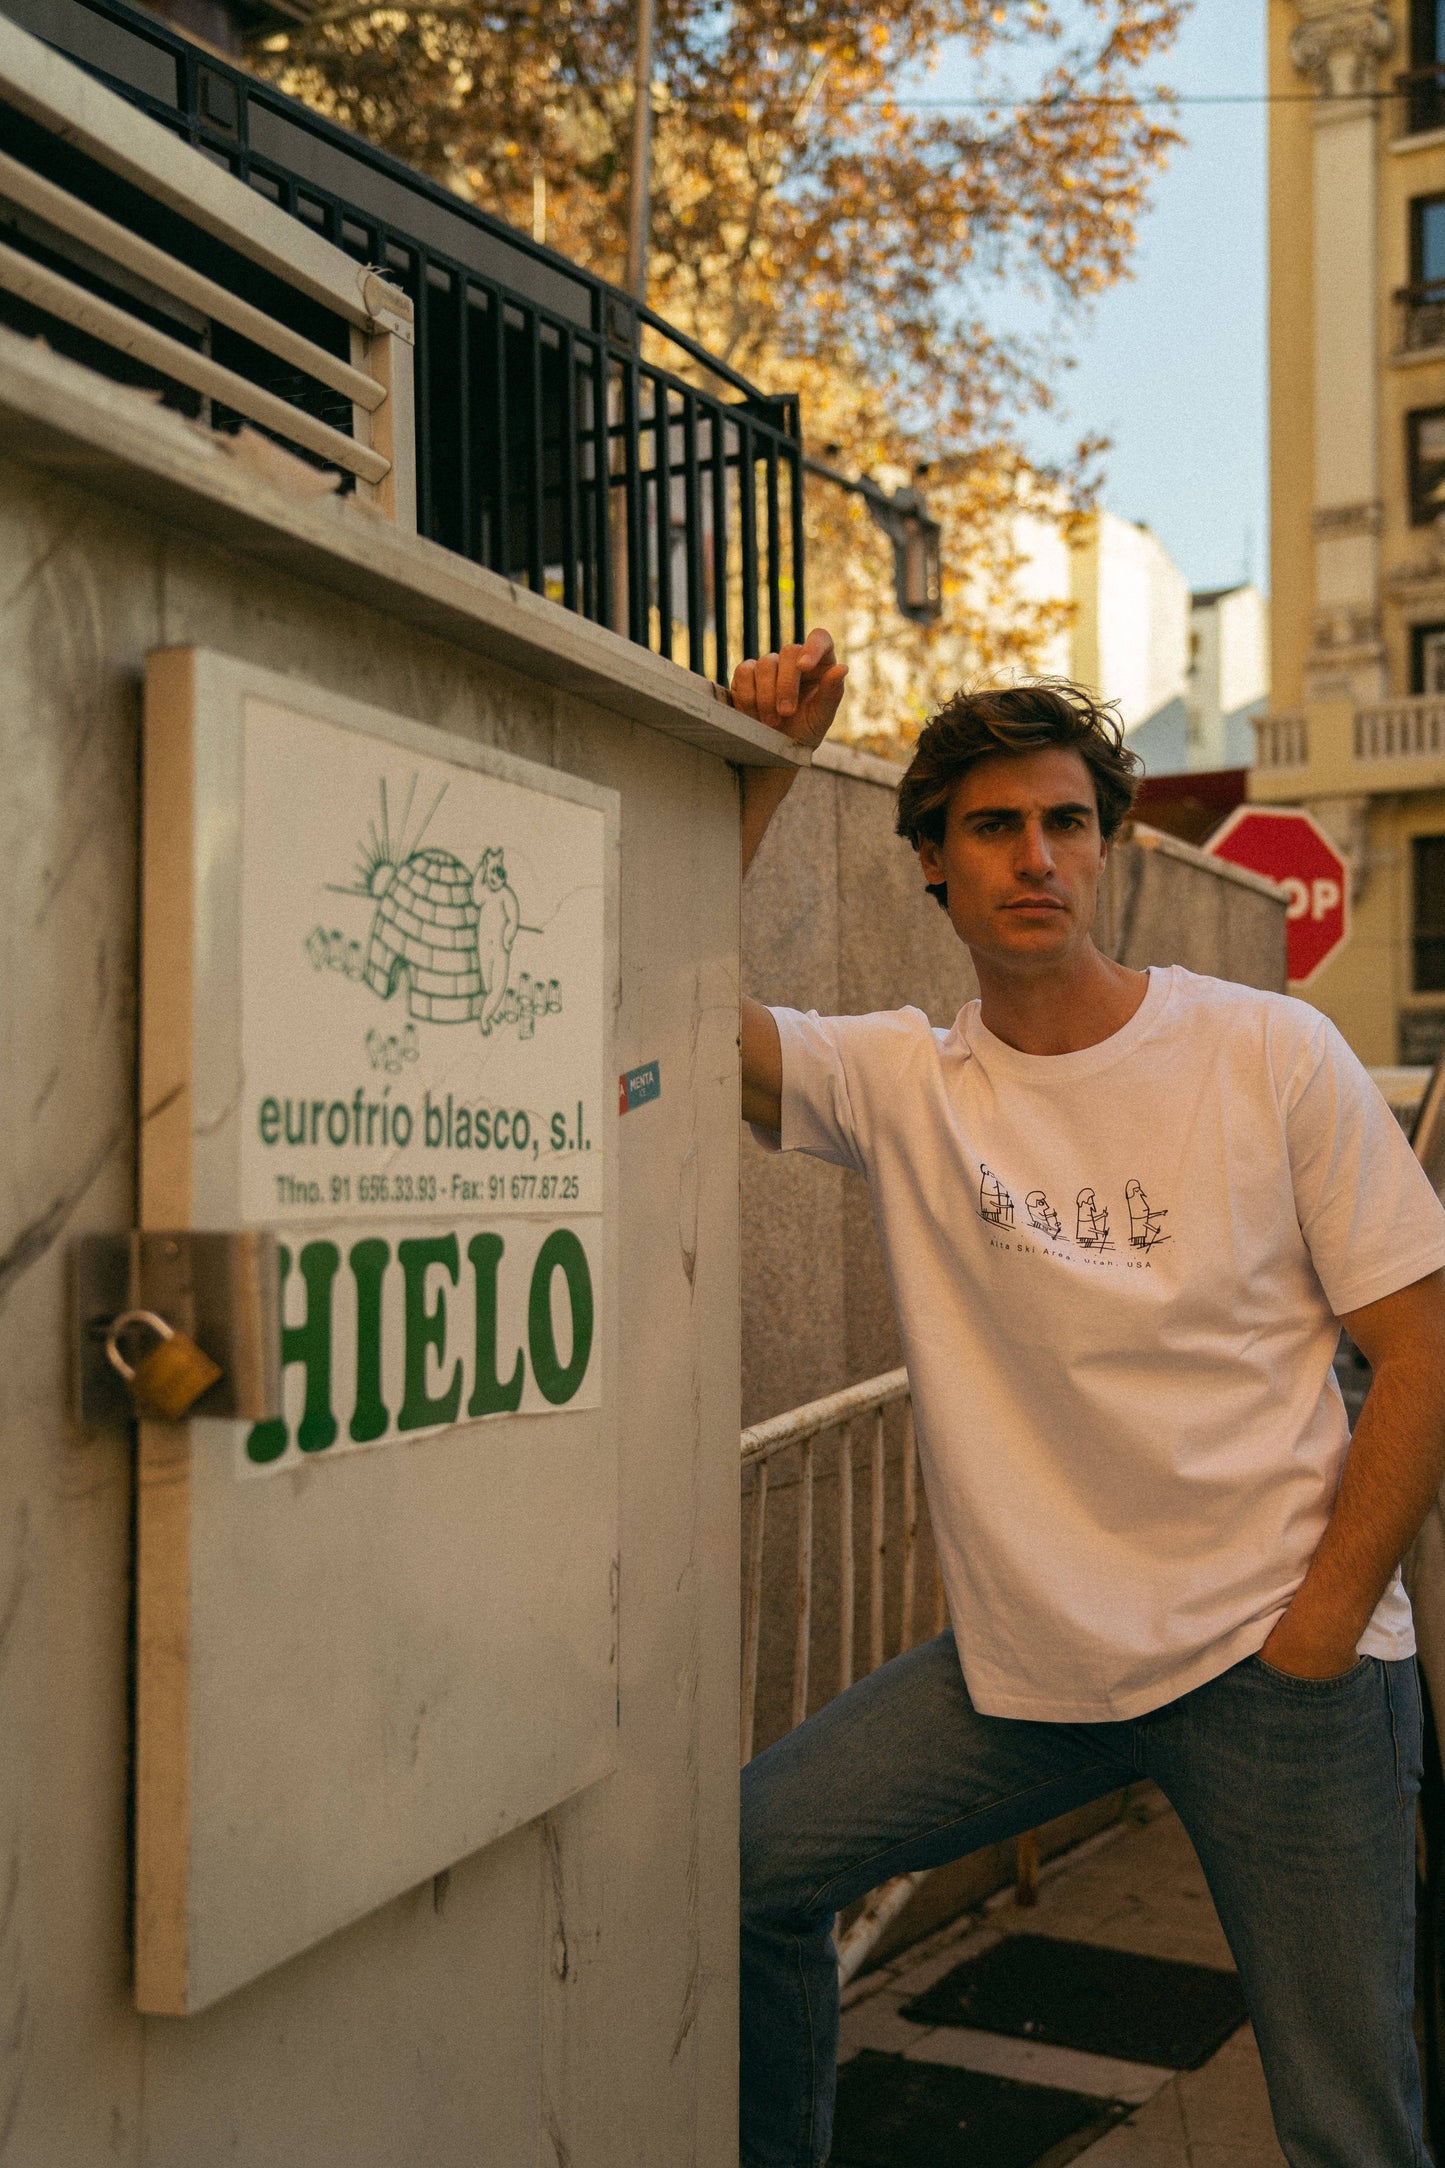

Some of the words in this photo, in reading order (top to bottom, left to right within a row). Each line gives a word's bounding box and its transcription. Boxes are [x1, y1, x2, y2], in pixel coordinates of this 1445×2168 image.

[1280, 877, 1340, 921] OP
[259, 1084, 412, 1146] eurofrío
[424, 1090, 540, 1161] blasco,
[550, 1100, 591, 1151] s.l.
[331, 1174, 349, 1203] 91
[452, 1173, 484, 1201] Fax:
[488, 1174, 505, 1201] 91
[511, 1174, 579, 1200] 677.87.25
[990, 1239, 1010, 1250] Alta
[1017, 1244, 1035, 1254] Ski
[1127, 1261, 1152, 1269] USA
[246, 1227, 595, 1464] HIELO
